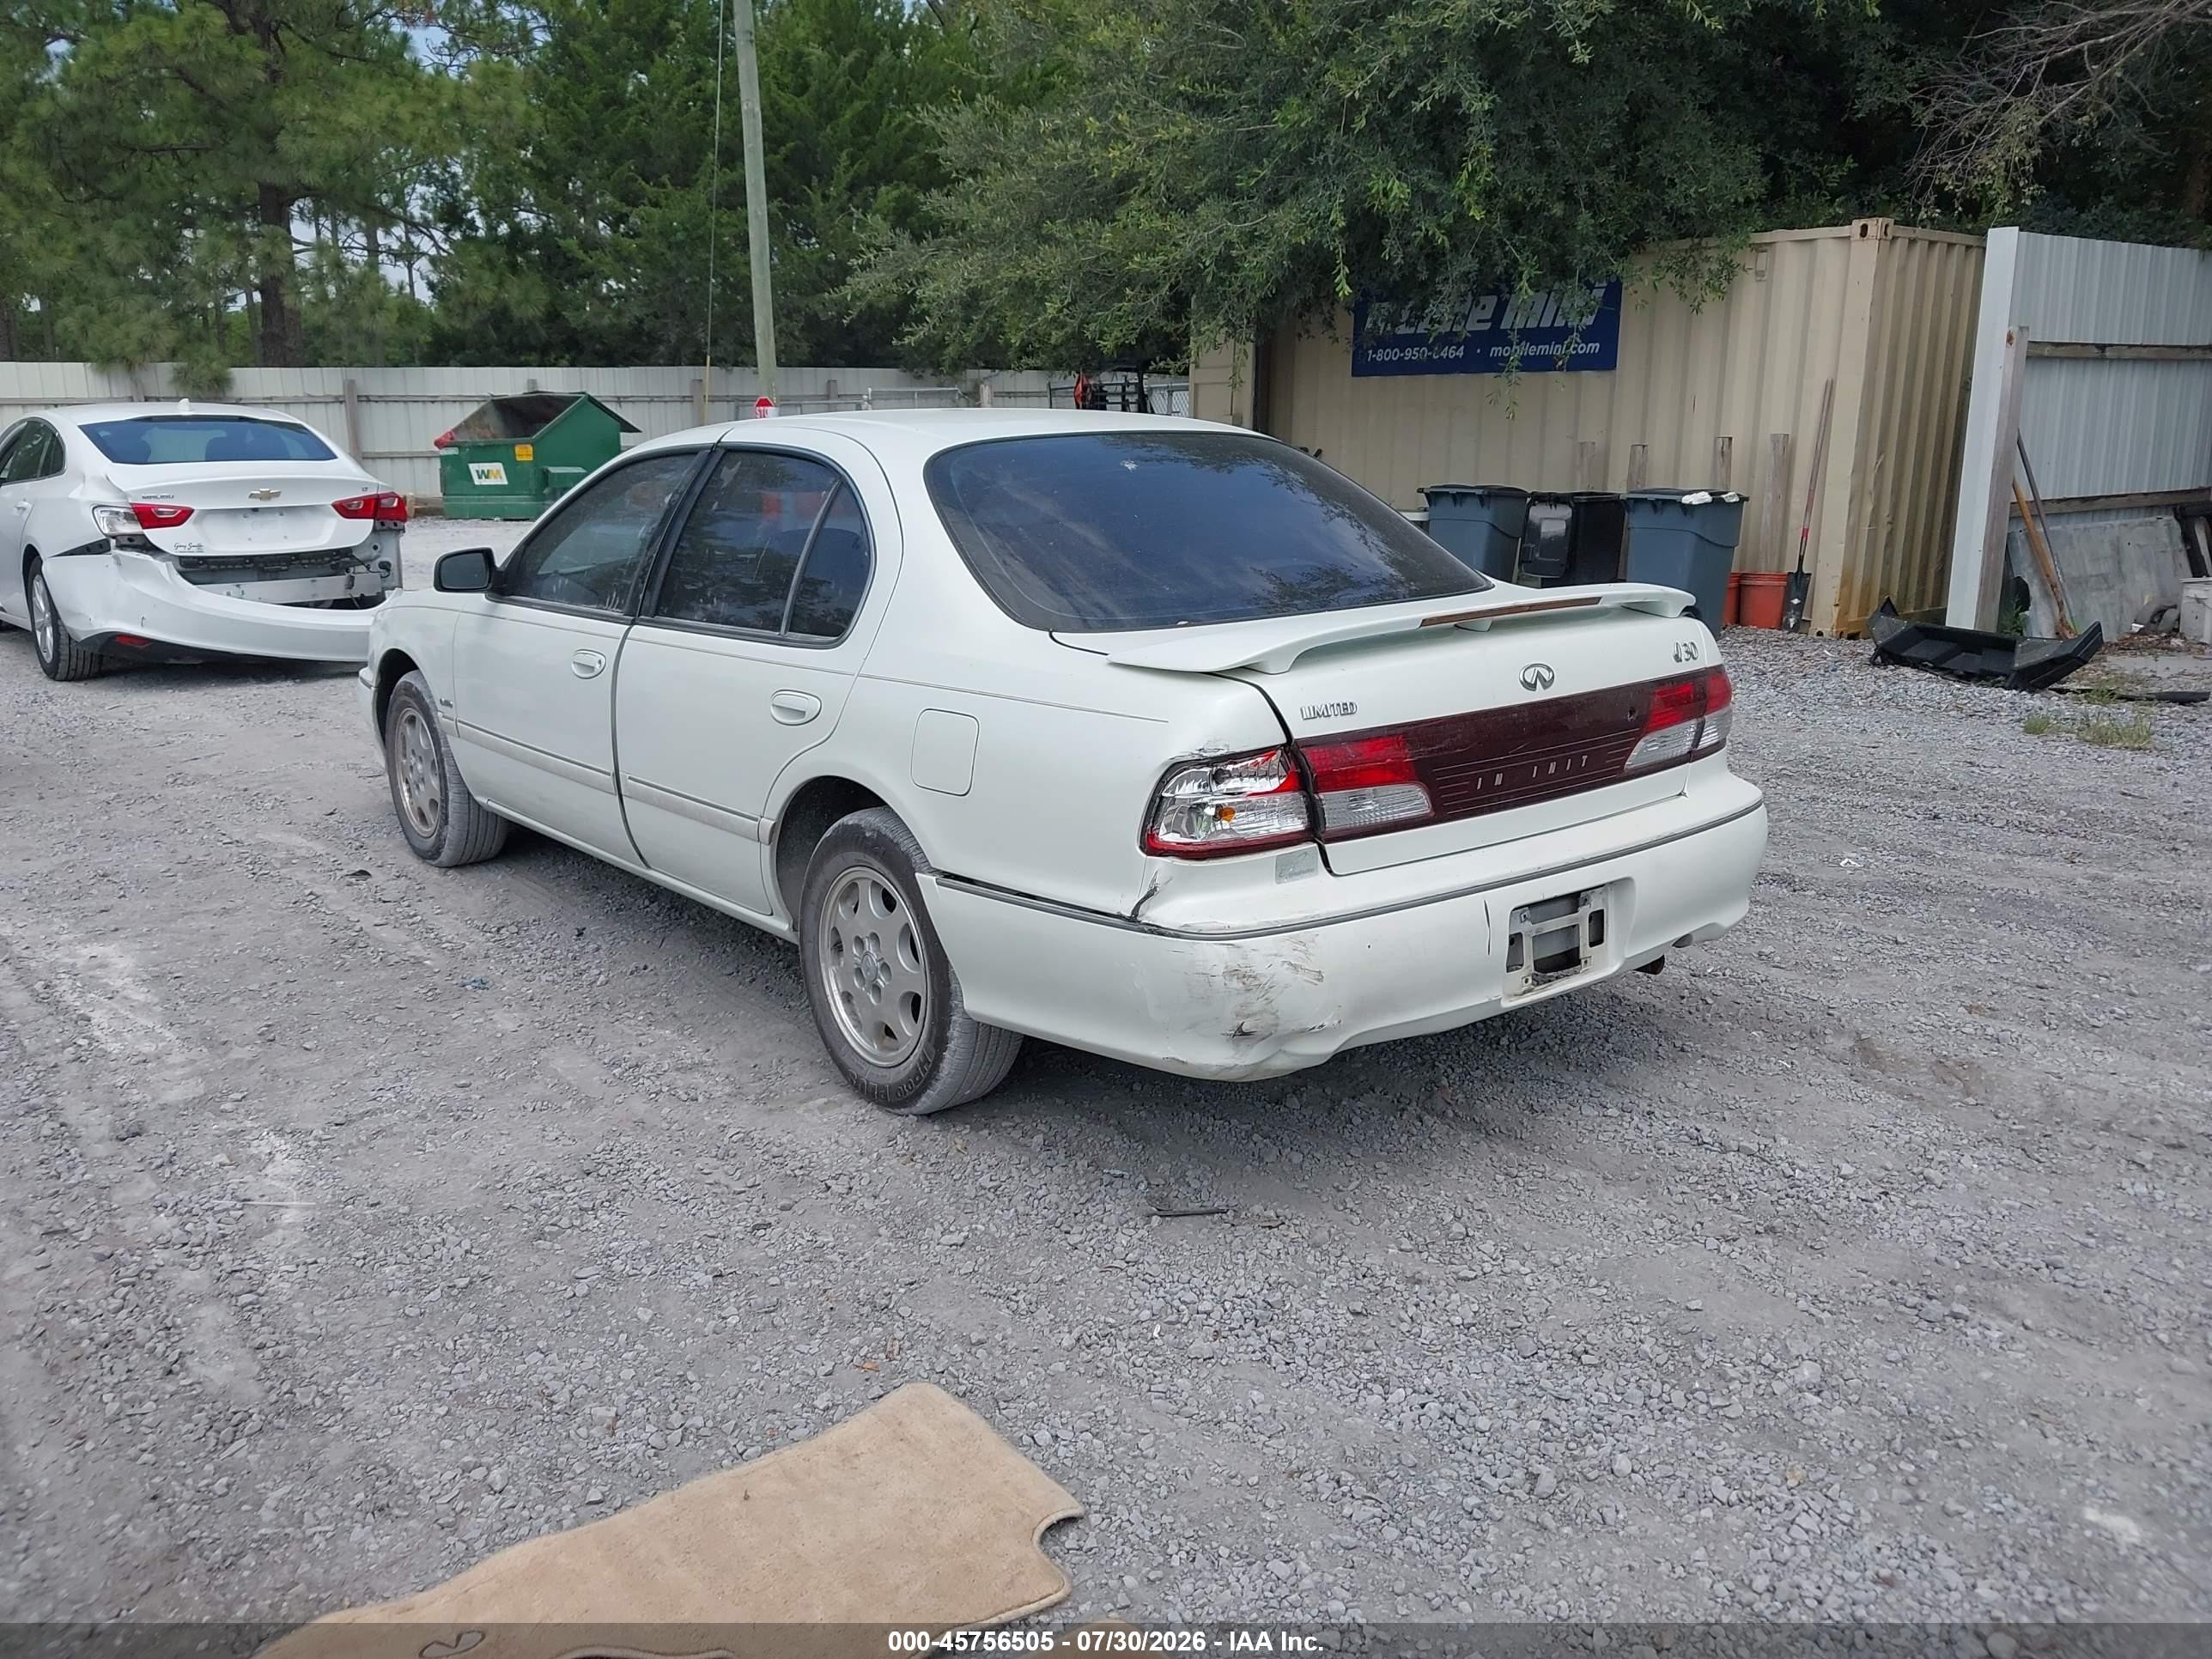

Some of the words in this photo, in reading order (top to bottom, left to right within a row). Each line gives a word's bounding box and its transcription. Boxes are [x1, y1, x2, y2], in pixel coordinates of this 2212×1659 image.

[1490, 340, 1600, 357] mobileminicom
[476, 469, 502, 479] WM
[1300, 702, 1358, 720] LIMITED
